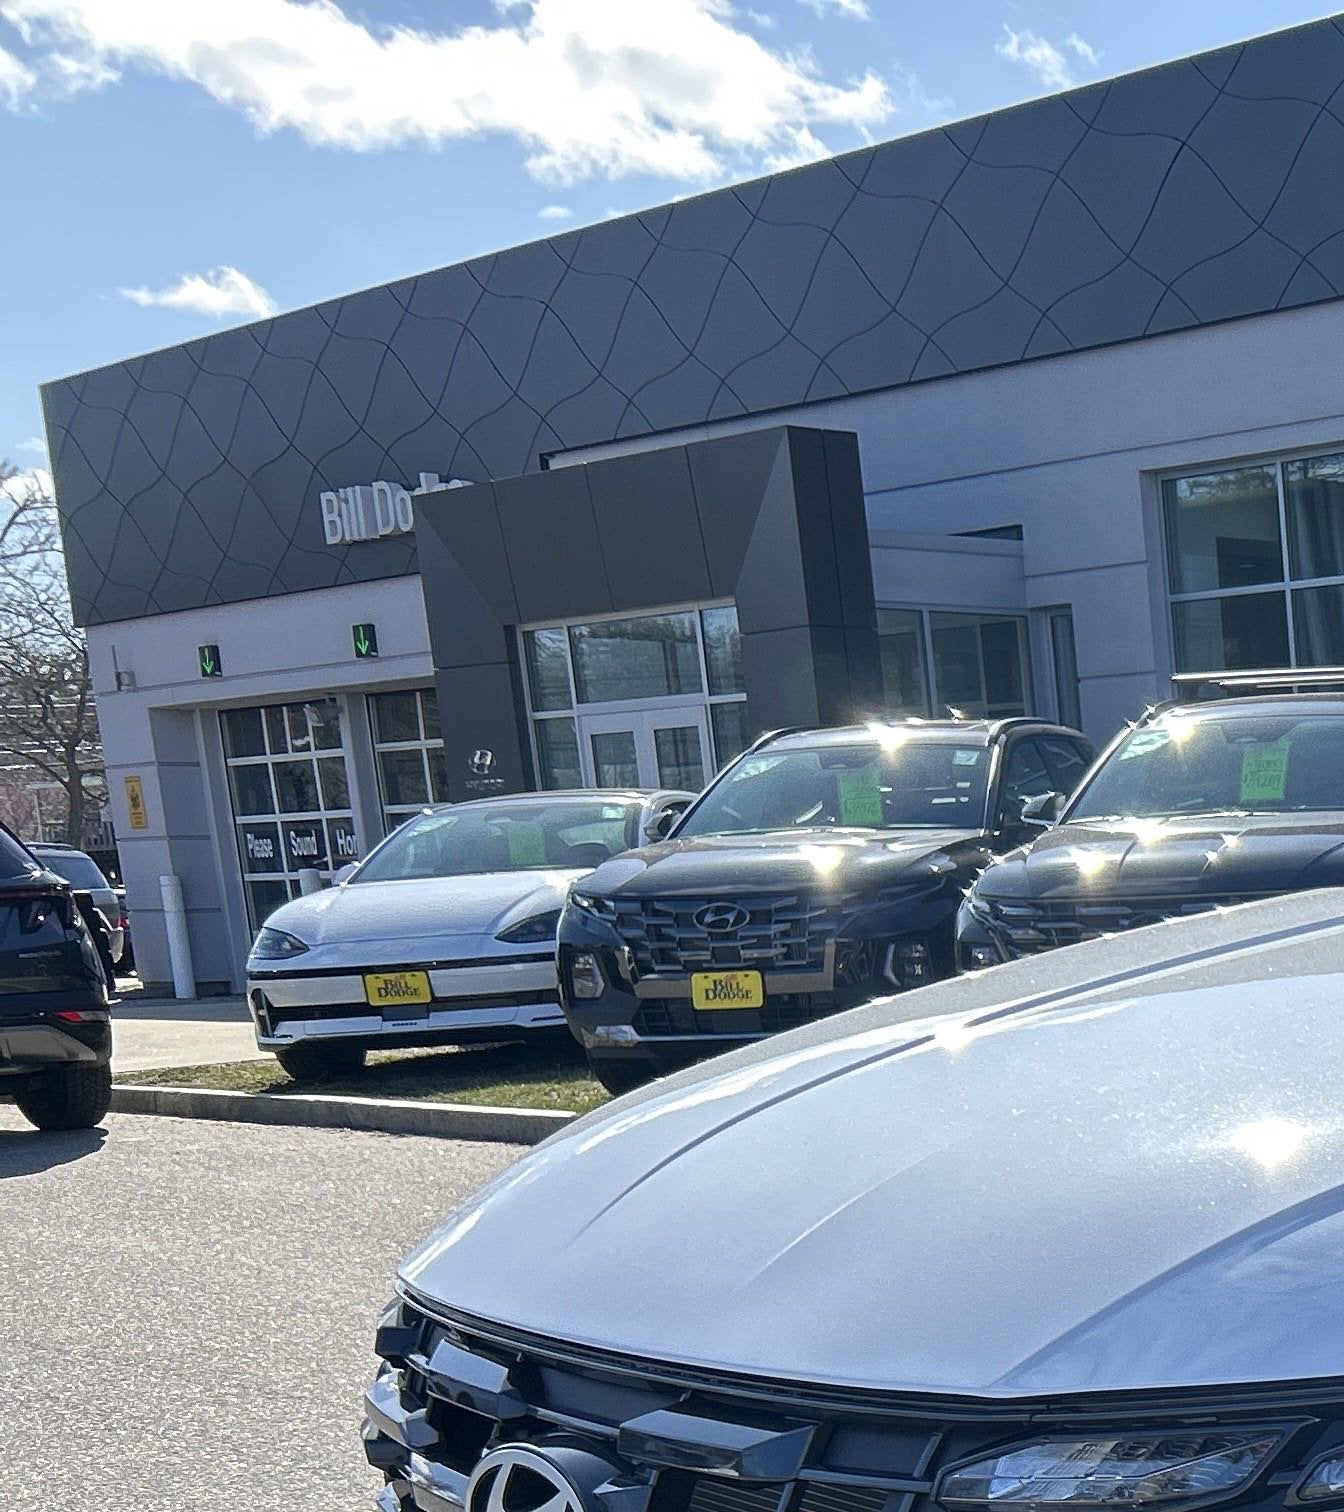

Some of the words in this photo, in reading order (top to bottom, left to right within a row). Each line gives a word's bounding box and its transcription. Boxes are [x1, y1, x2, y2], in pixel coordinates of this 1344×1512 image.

[320, 485, 366, 545] Bill
[246, 833, 273, 859] Please
[290, 830, 318, 857] Sound
[704, 988, 753, 1001] DODGE
[712, 979, 744, 992] BILL
